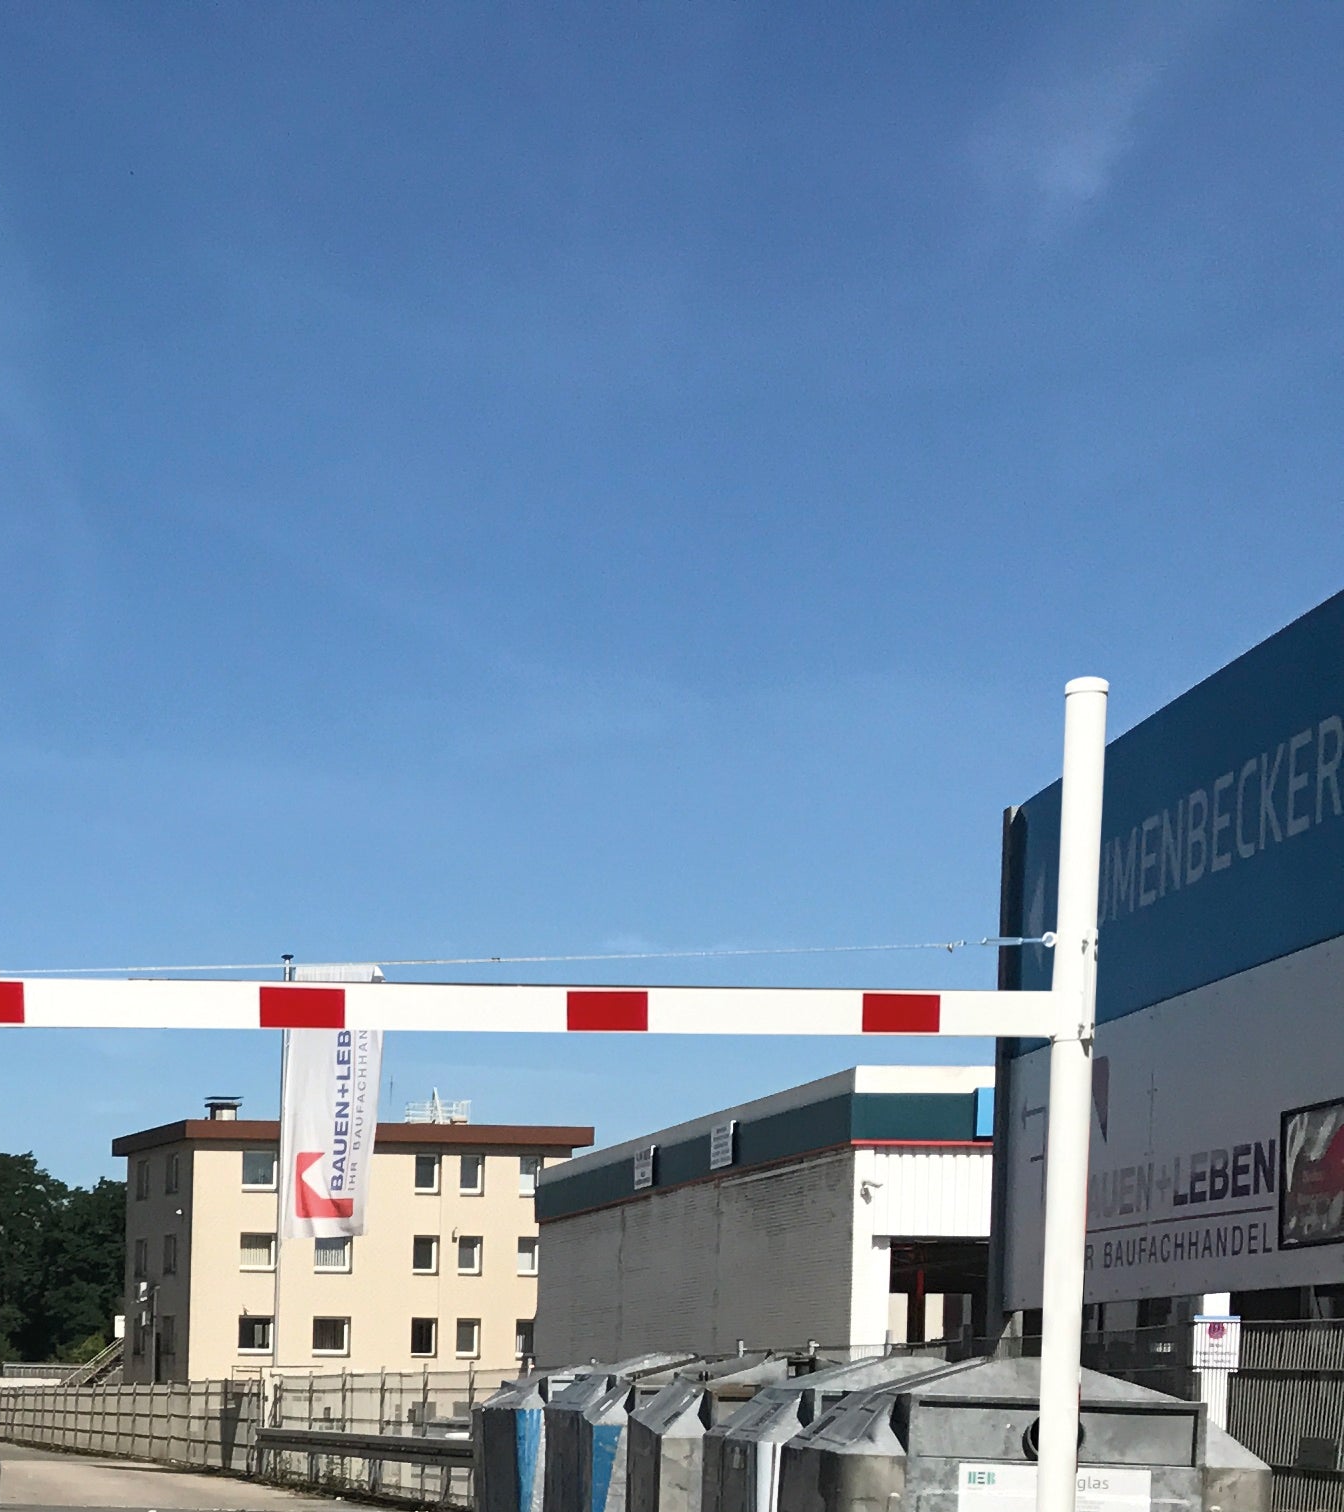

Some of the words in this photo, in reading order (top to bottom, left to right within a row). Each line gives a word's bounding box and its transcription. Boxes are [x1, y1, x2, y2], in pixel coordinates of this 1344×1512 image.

[330, 1030, 352, 1192] BAUEN+LEB
[352, 1030, 368, 1151] BAUFACHHAN
[1088, 1138, 1276, 1221] AUEN+LEBEN
[1103, 1222, 1273, 1269] BAUFACHHANDEL
[1077, 1476, 1110, 1492] glas
